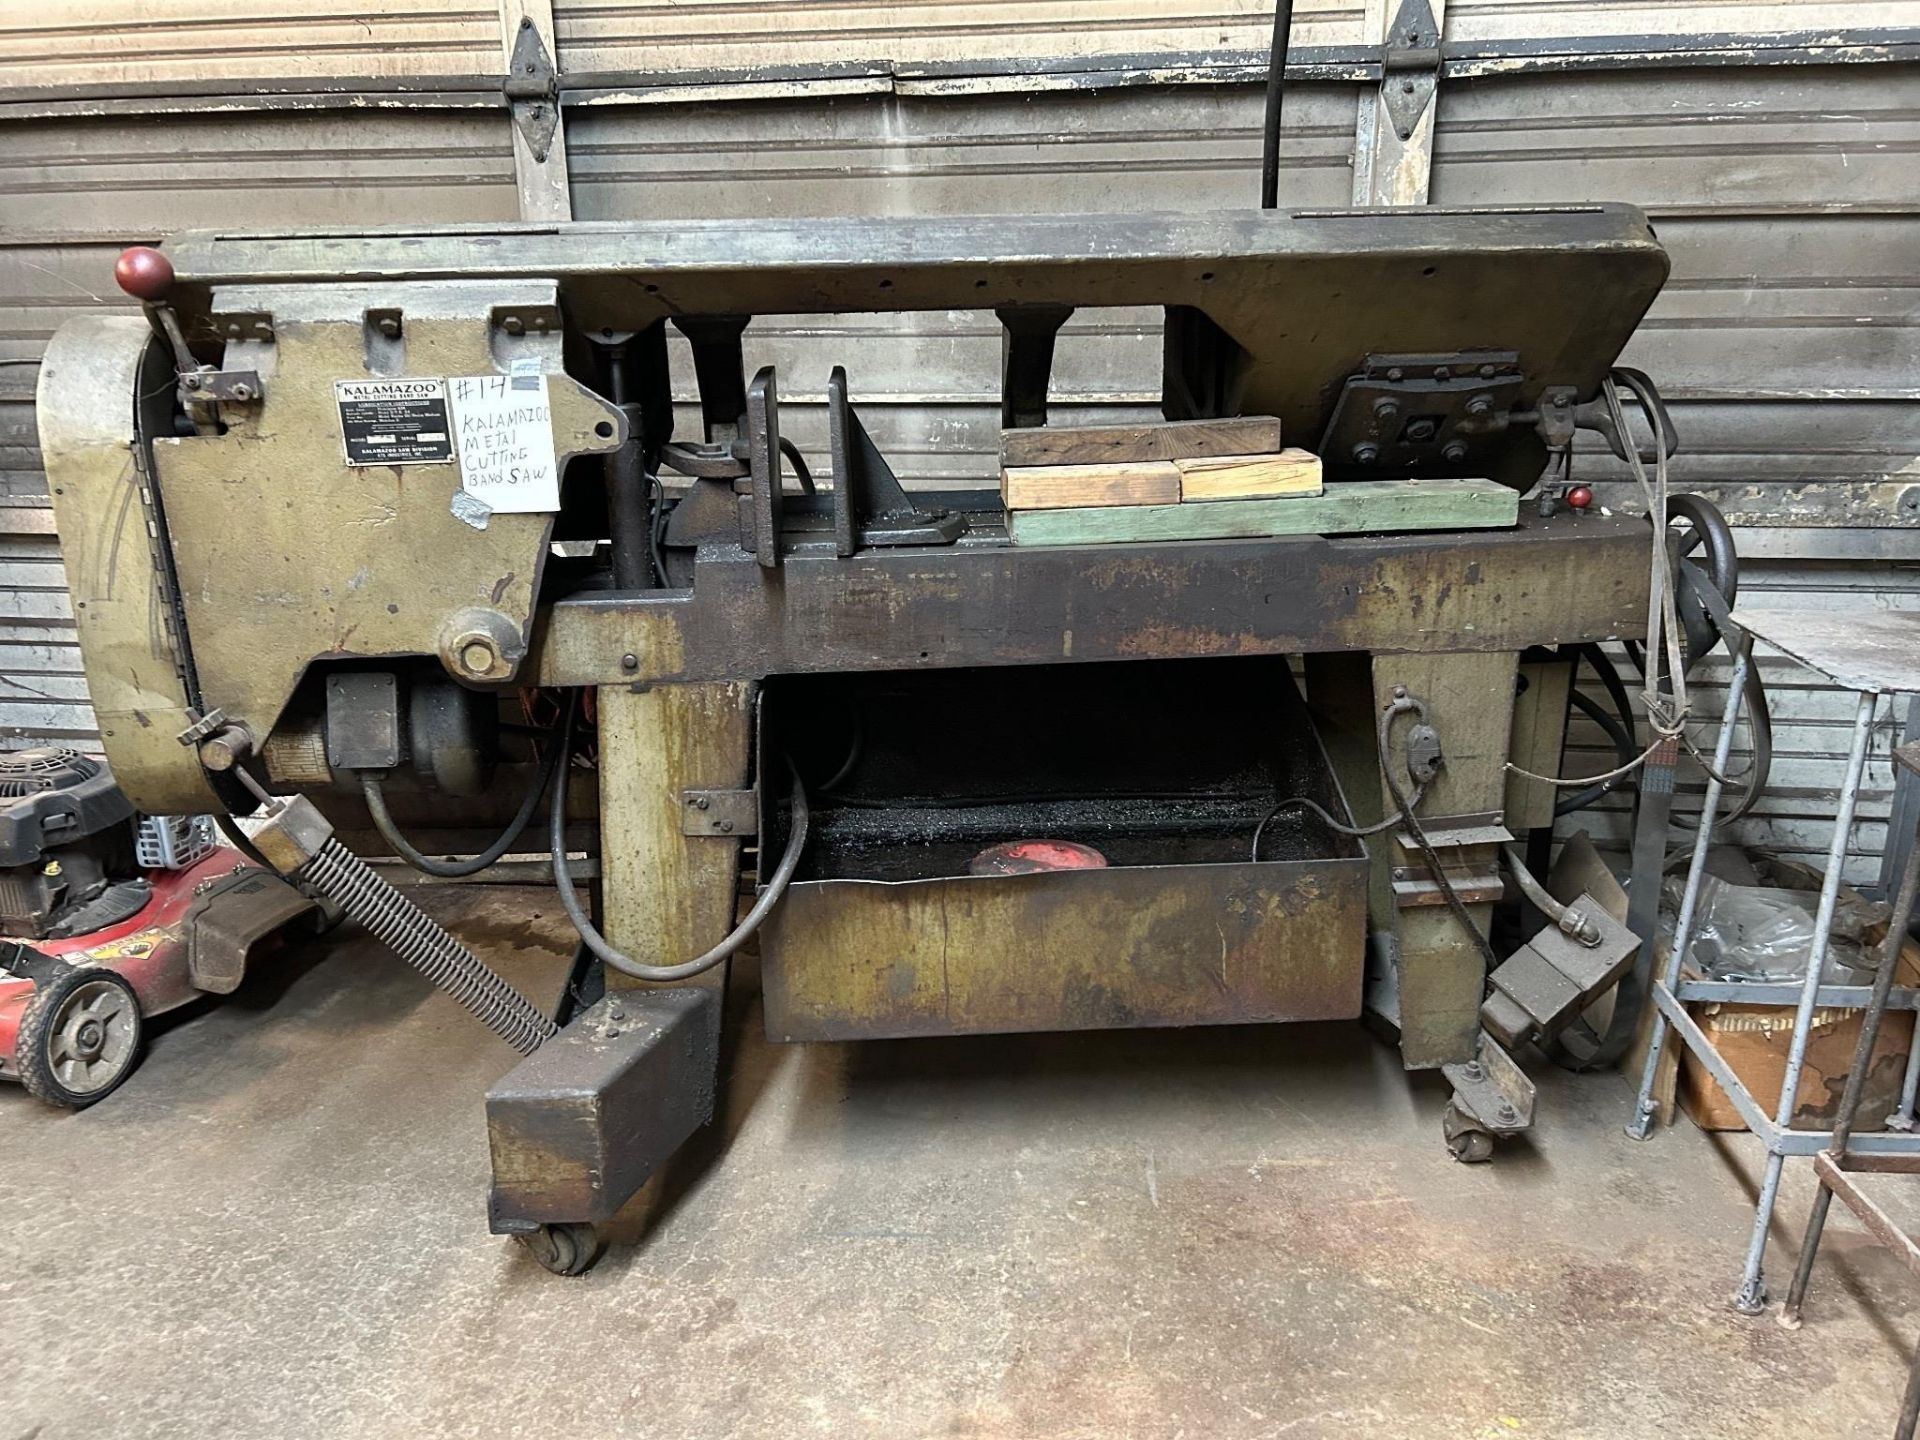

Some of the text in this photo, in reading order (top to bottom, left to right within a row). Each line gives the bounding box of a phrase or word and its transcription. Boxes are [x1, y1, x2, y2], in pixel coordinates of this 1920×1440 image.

[344, 384, 436, 396] KALAMAZOO
[456, 376, 506, 402] #14
[463, 406, 549, 433] KALAMAZOO
[465, 447, 528, 472] CUTTING
[507, 466, 547, 484] SAW
